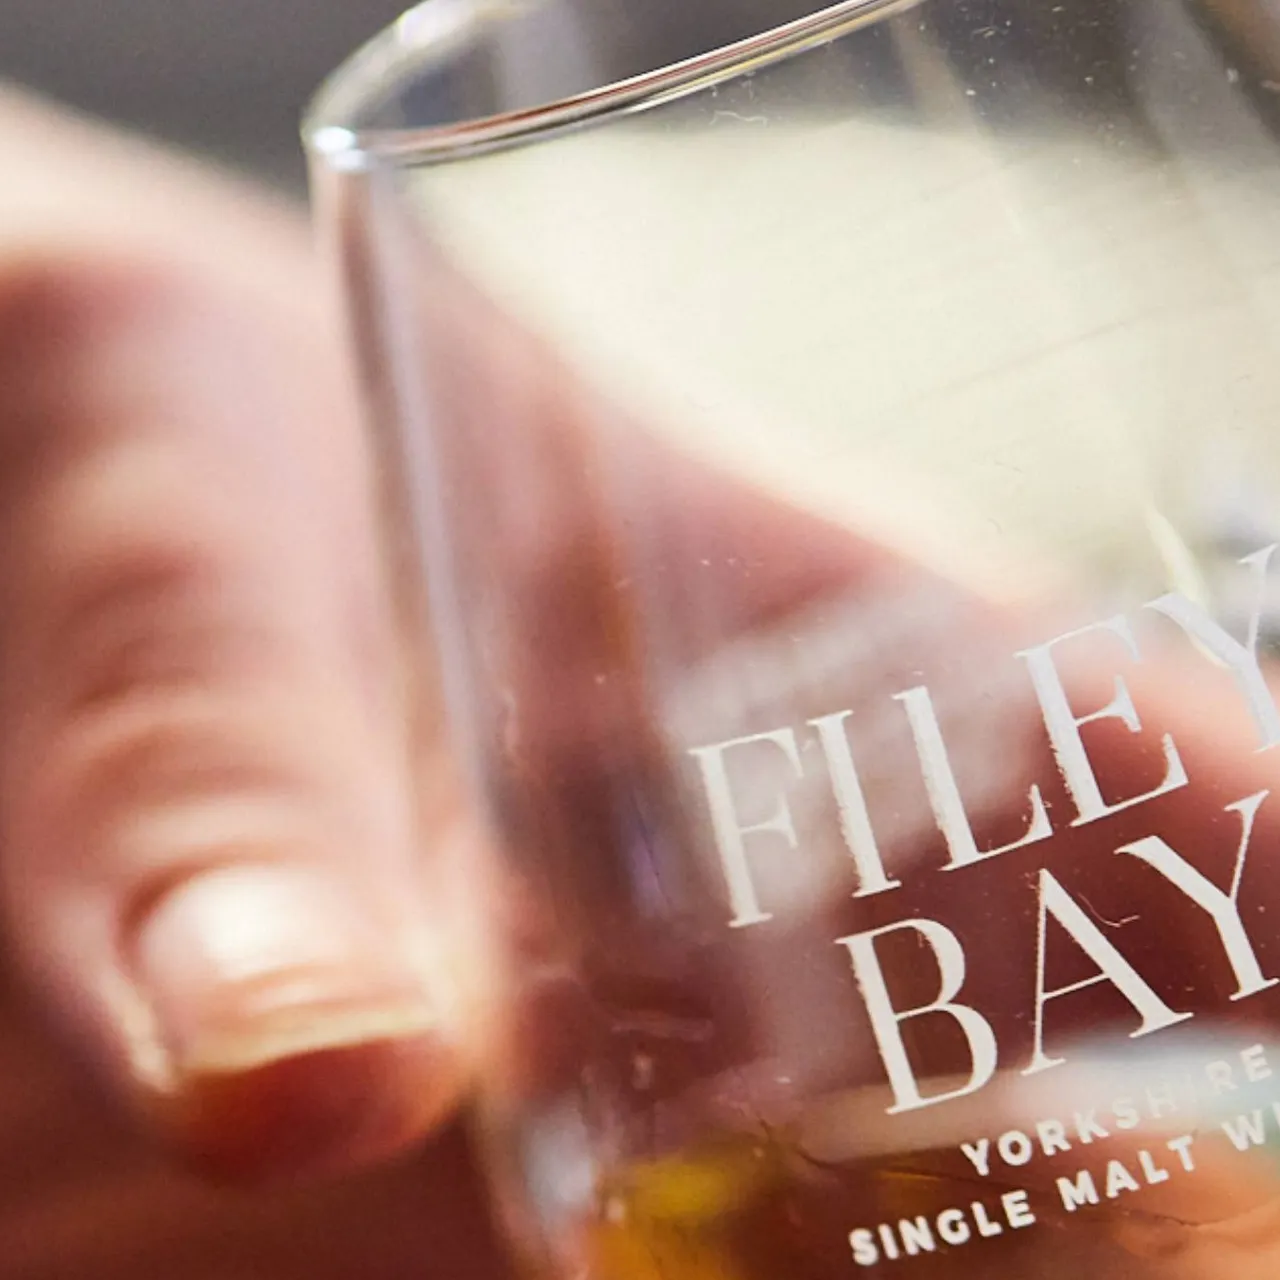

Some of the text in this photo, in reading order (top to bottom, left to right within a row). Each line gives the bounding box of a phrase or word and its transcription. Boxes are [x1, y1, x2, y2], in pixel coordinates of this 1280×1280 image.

[834, 789, 1280, 1115] BAY
[961, 1044, 1273, 1177] YORKSHIRE
[849, 1190, 1036, 1266] SINGLE
[1057, 1136, 1196, 1211] MALT
